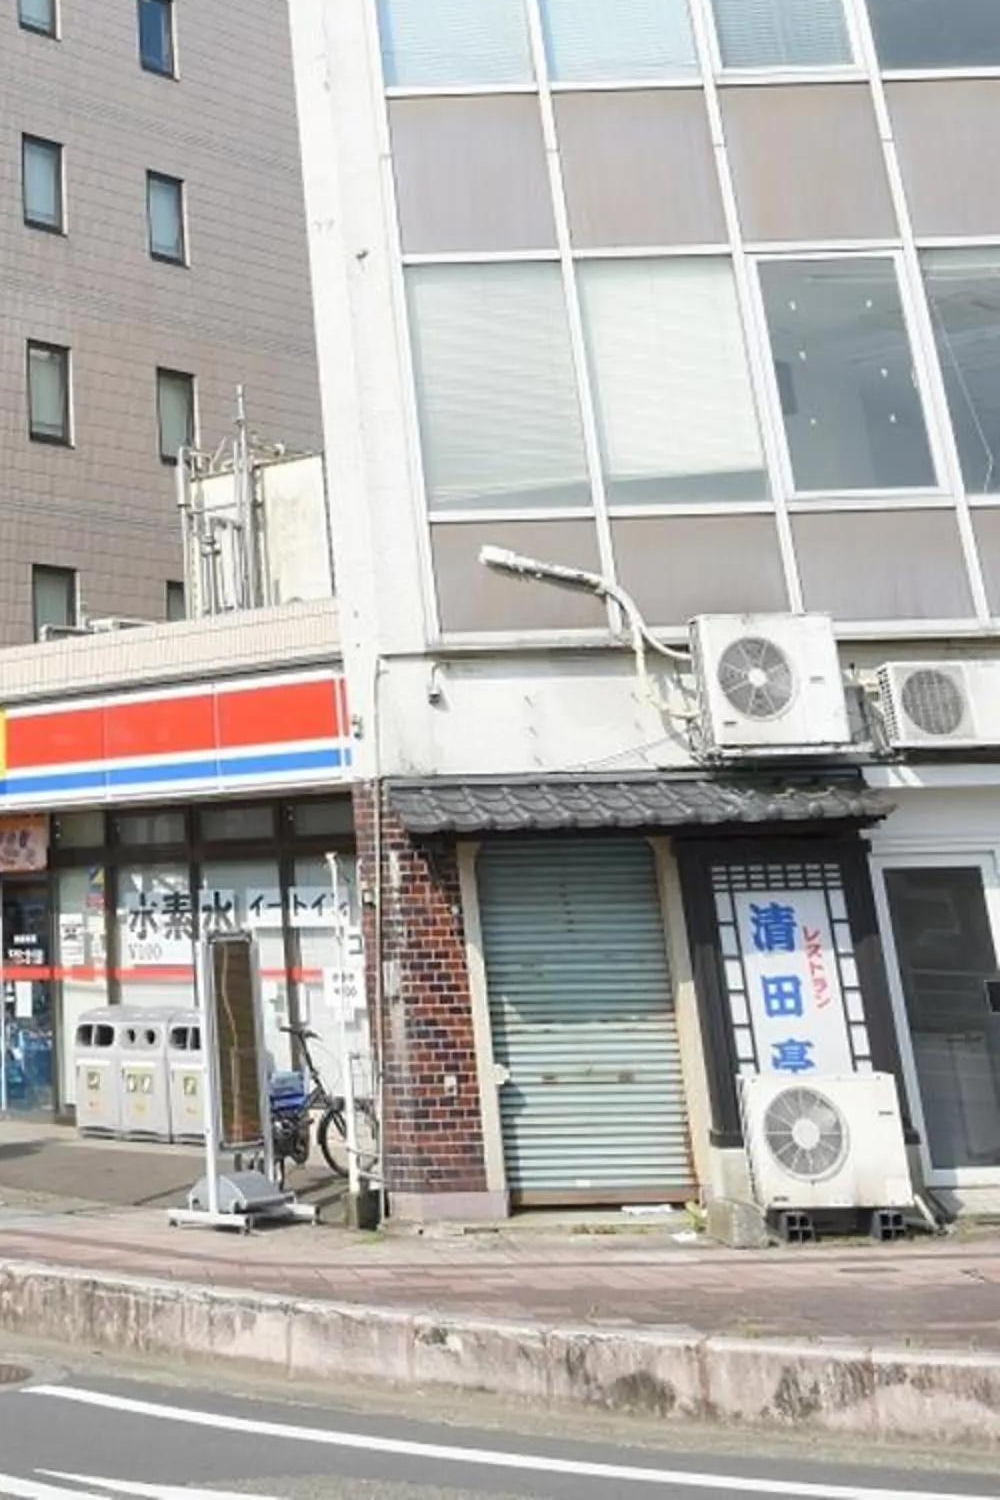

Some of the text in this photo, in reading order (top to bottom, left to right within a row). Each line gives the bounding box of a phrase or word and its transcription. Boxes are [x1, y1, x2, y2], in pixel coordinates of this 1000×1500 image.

[128, 890, 234, 942] 水素水
[748, 902, 816, 1074] 清田亭
[803, 925, 831, 1009] レストラン
